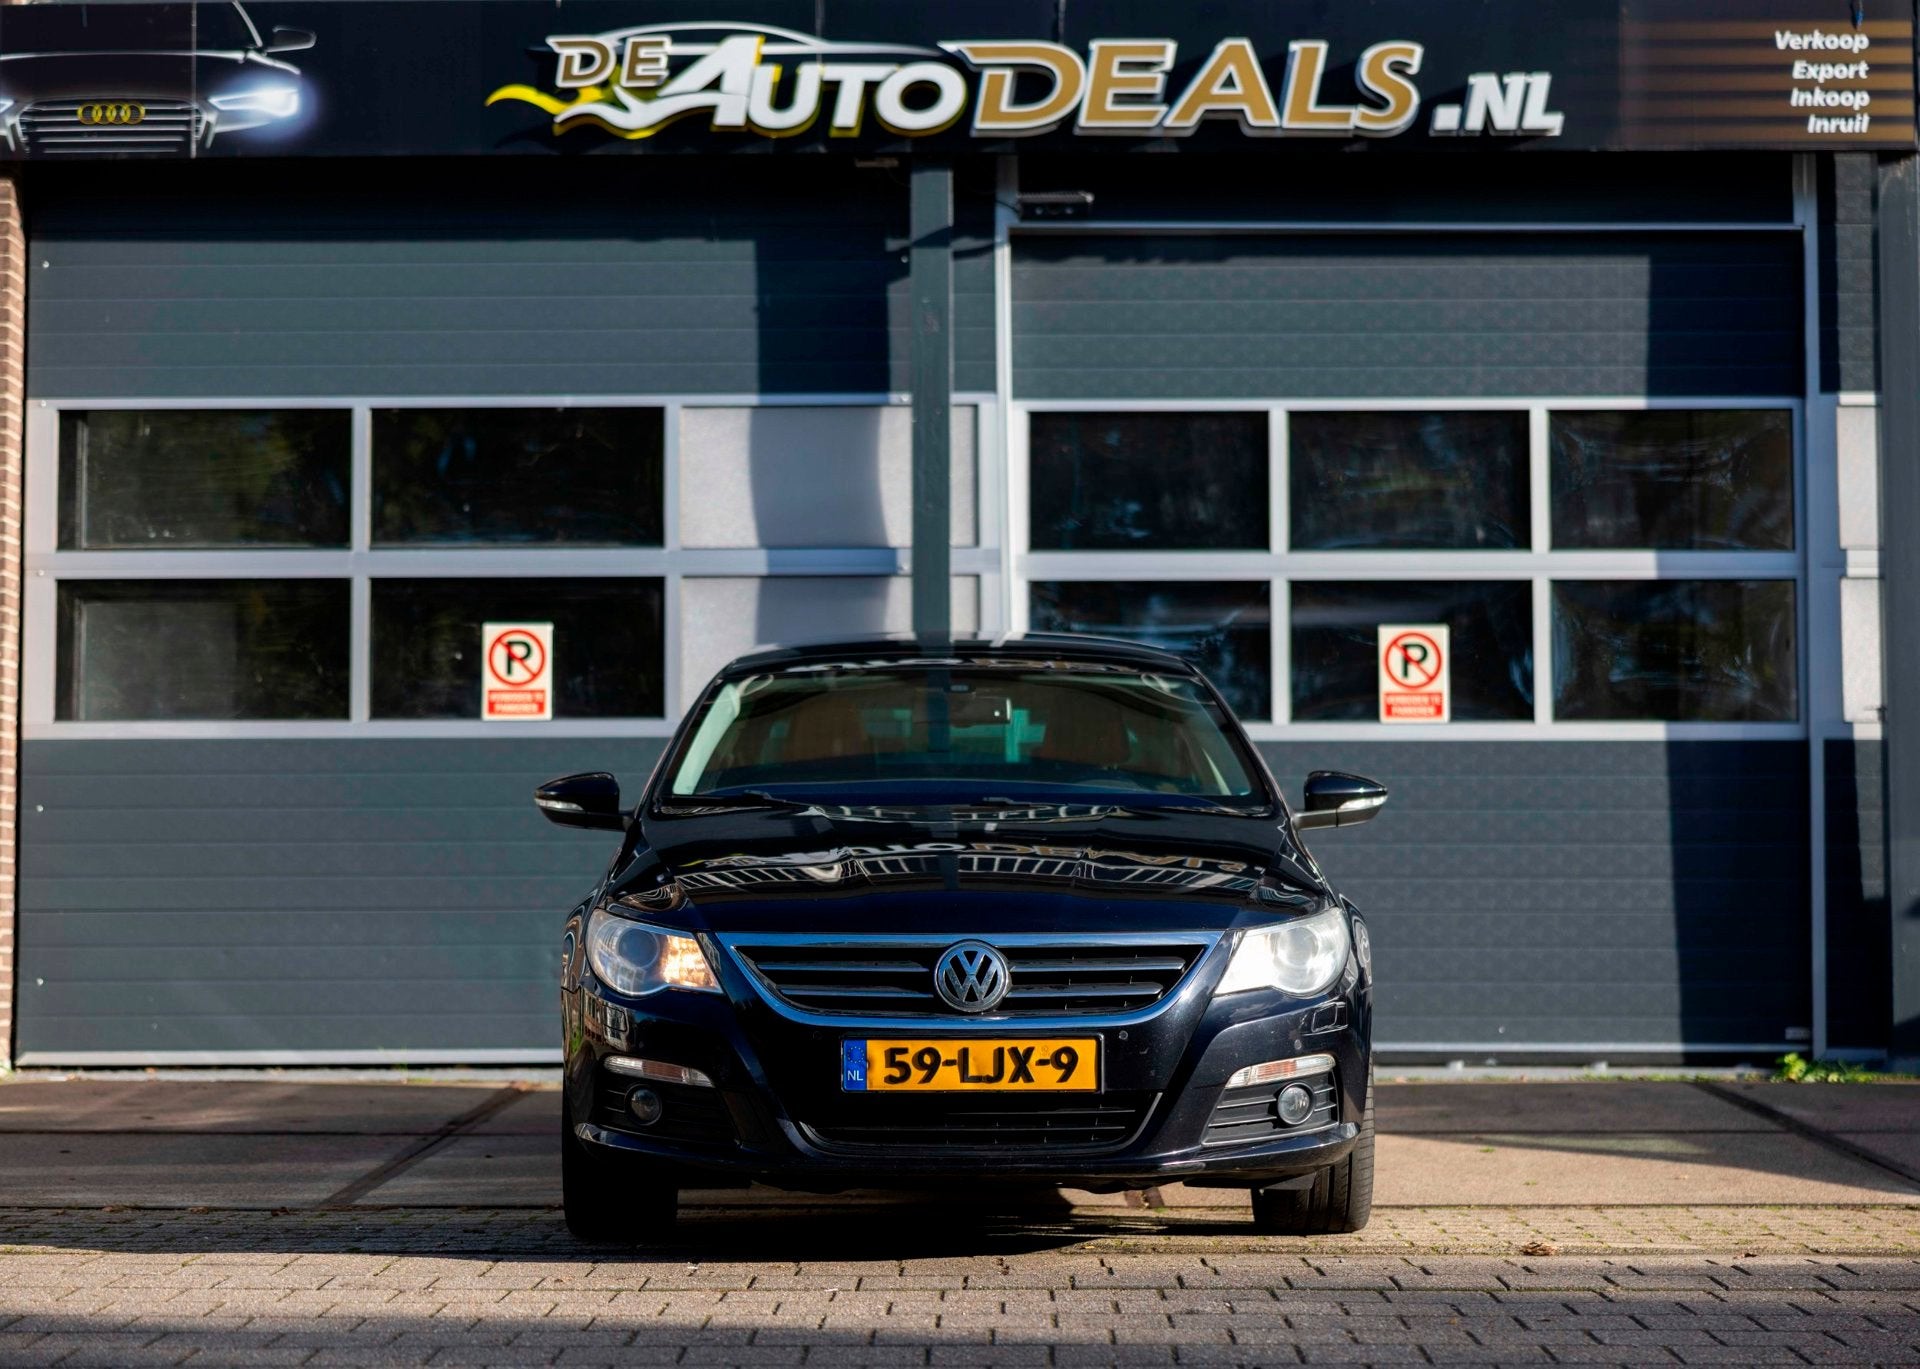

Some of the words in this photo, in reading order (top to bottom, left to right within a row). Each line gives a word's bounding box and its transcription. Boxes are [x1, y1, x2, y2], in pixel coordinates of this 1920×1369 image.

[1774, 29, 1870, 54] Verkoop
[1792, 59, 1870, 83] Export
[1790, 86, 1871, 111] Inkoop
[1807, 113, 1871, 134] Inruil
[847, 1070, 864, 1081] NL
[883, 1046, 1079, 1085] 59-LJX-9
